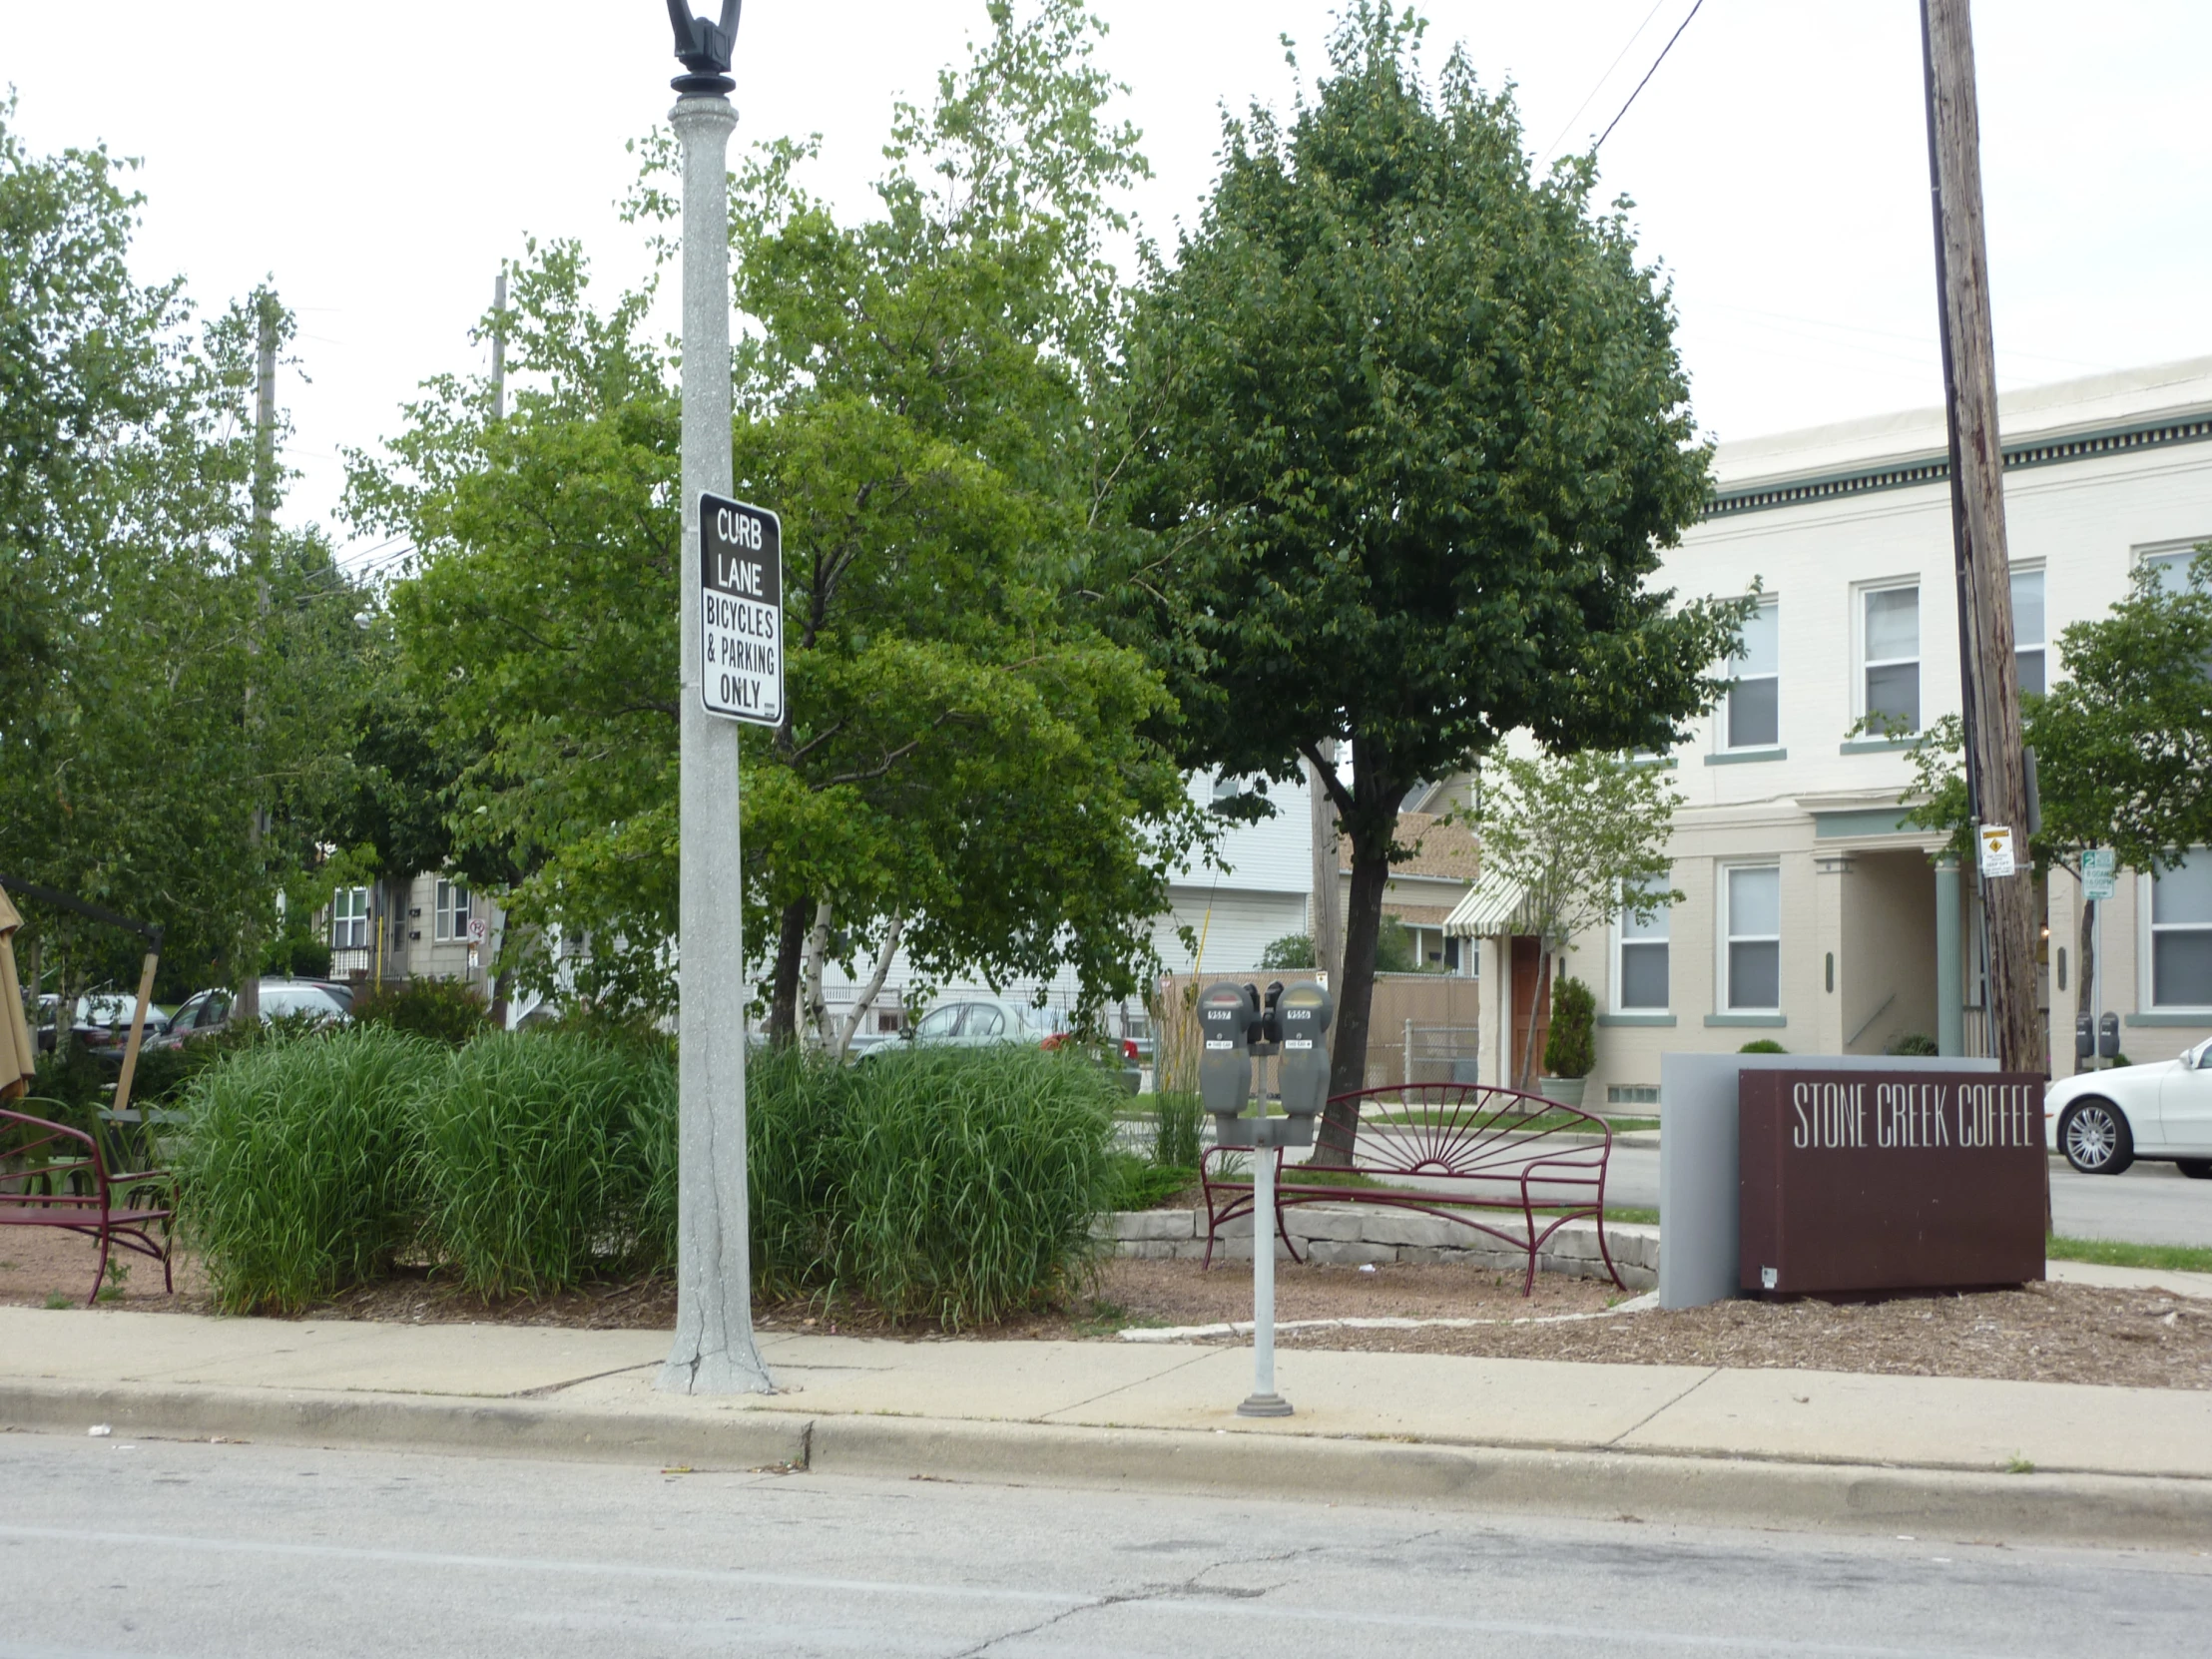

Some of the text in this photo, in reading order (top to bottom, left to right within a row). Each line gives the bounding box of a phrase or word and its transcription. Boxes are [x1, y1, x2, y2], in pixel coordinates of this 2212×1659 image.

[717, 507, 763, 551] CURB
[718, 553, 763, 597] LANE
[707, 595, 774, 639] BICYCLES
[707, 632, 775, 676] & PARKING
[721, 674, 761, 709] ONLY
[1793, 1082, 2033, 1149] STONE CREEK COFFEE
